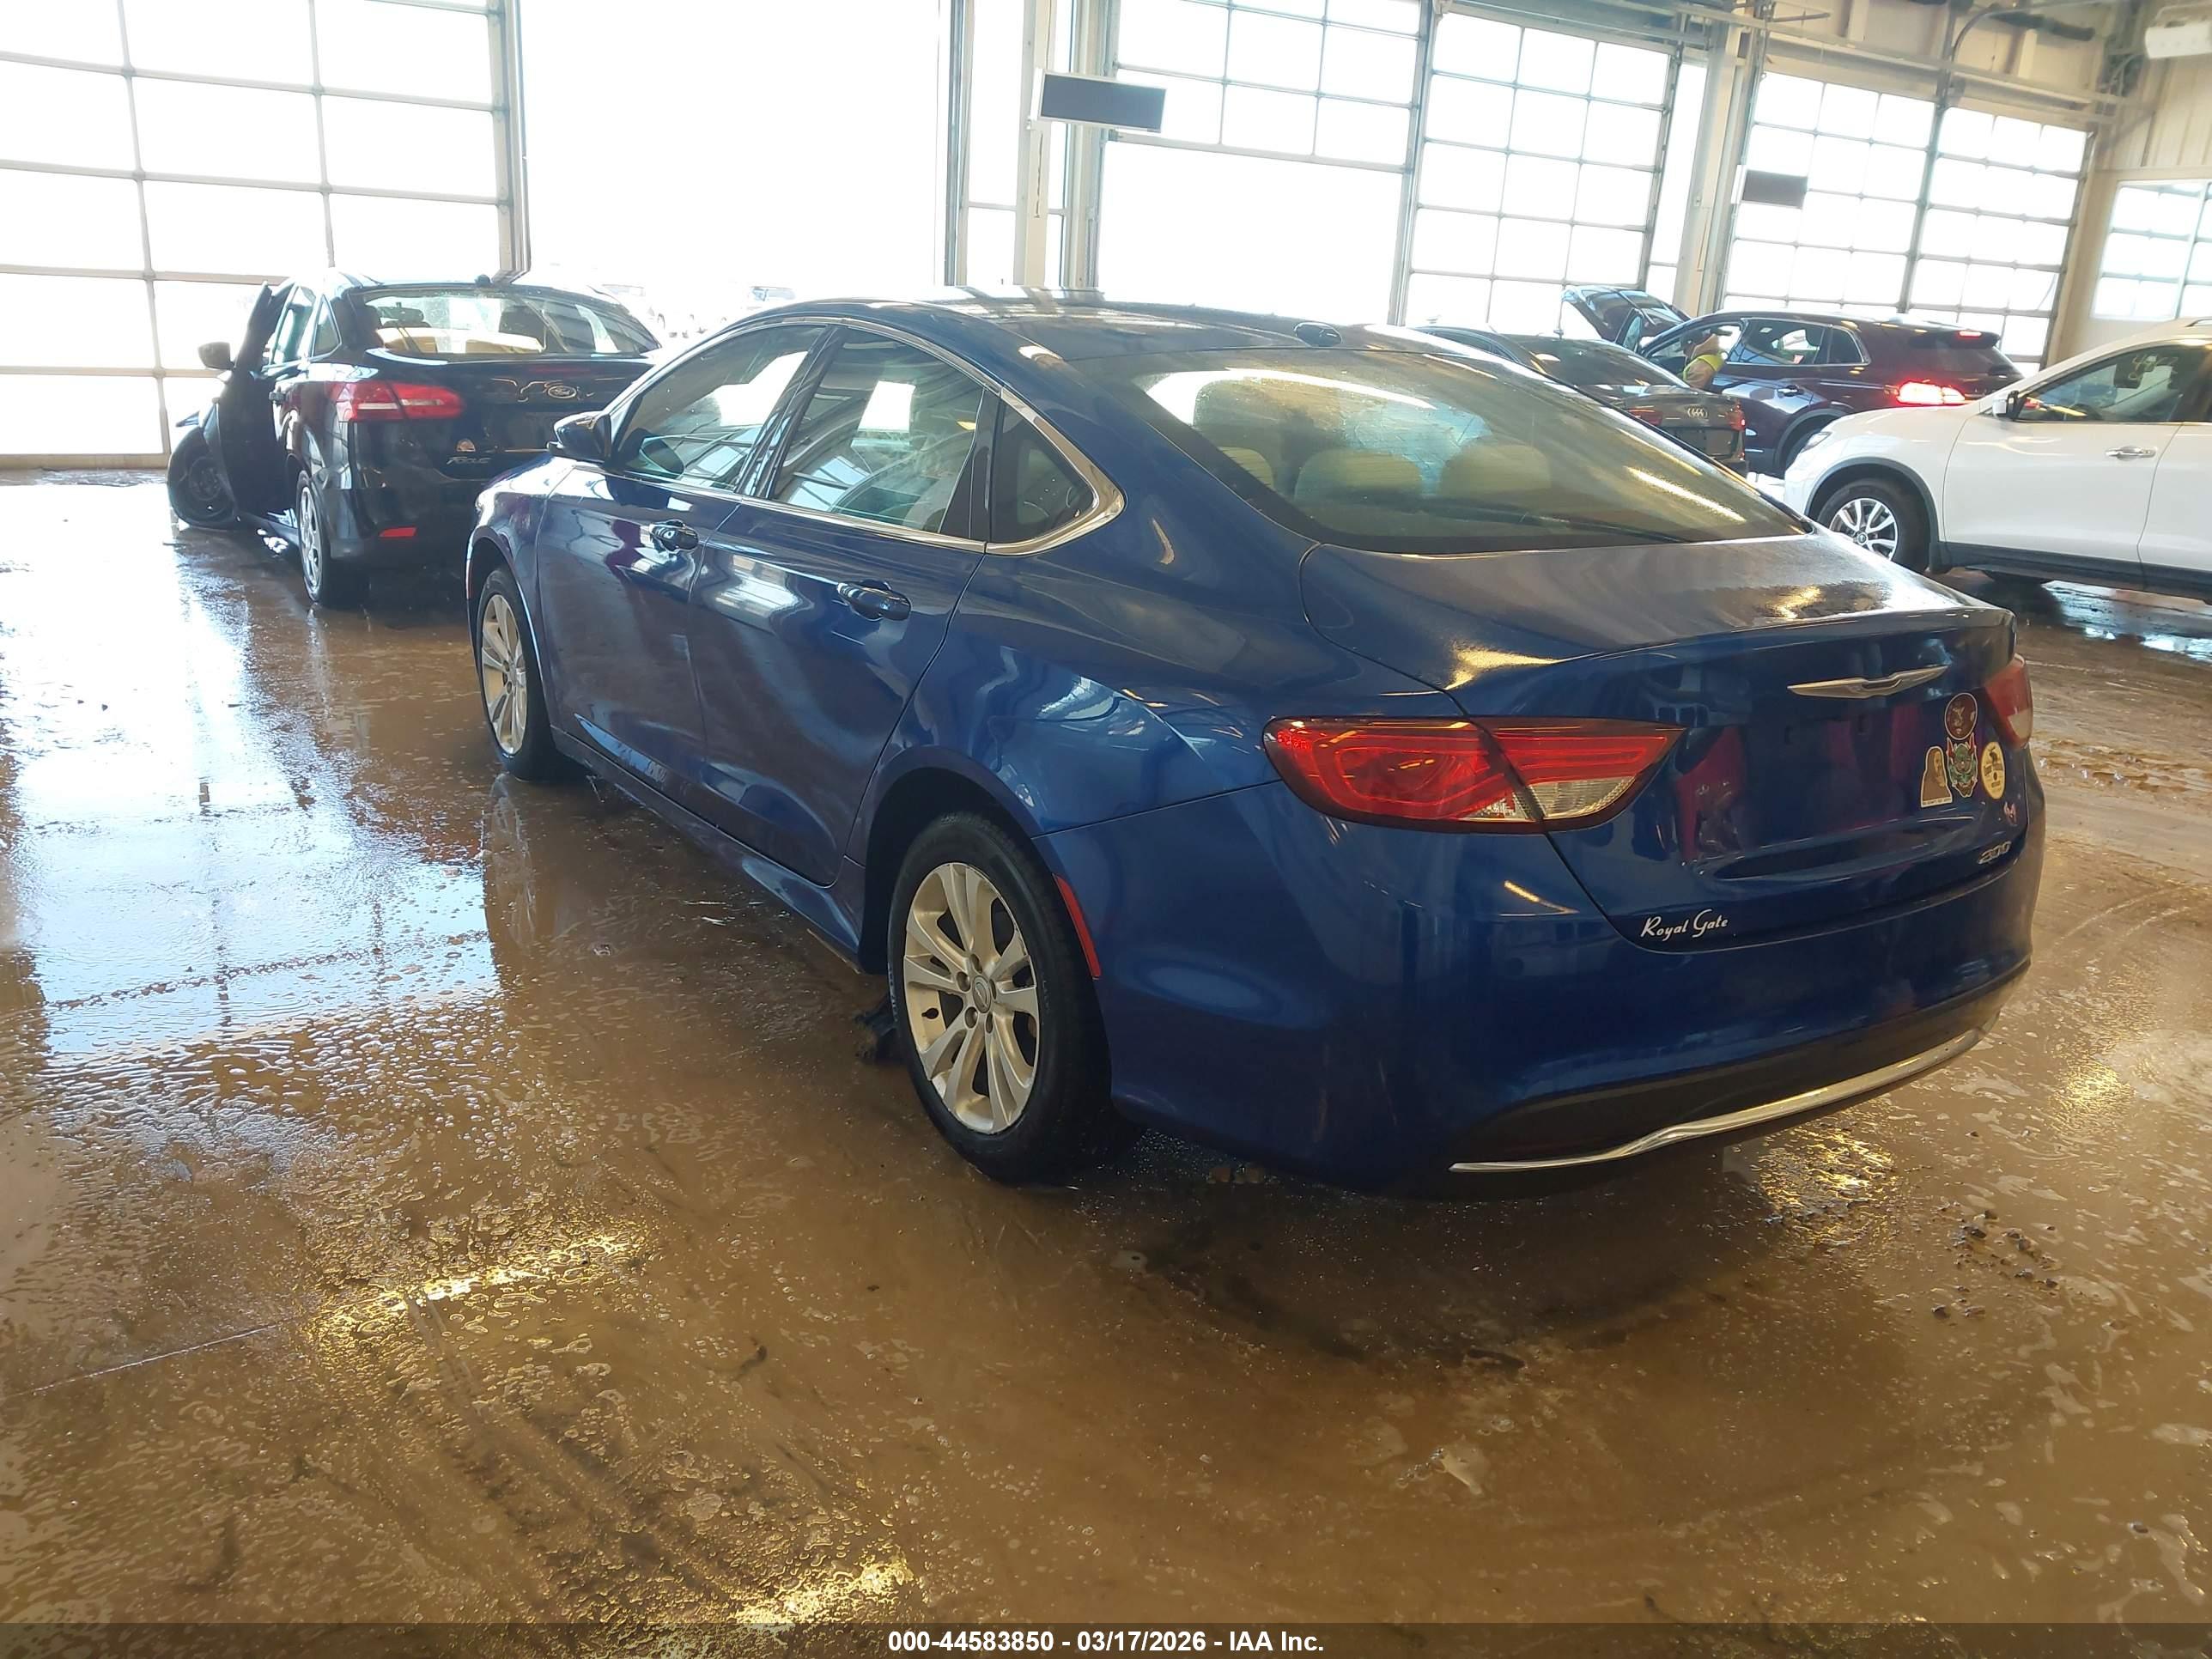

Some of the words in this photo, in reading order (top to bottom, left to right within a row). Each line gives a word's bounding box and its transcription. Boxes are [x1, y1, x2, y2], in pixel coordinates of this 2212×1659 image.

[1978, 841, 2012, 864] 200
[1640, 915, 1689, 942] Royal
[1692, 908, 1729, 939] Gate
